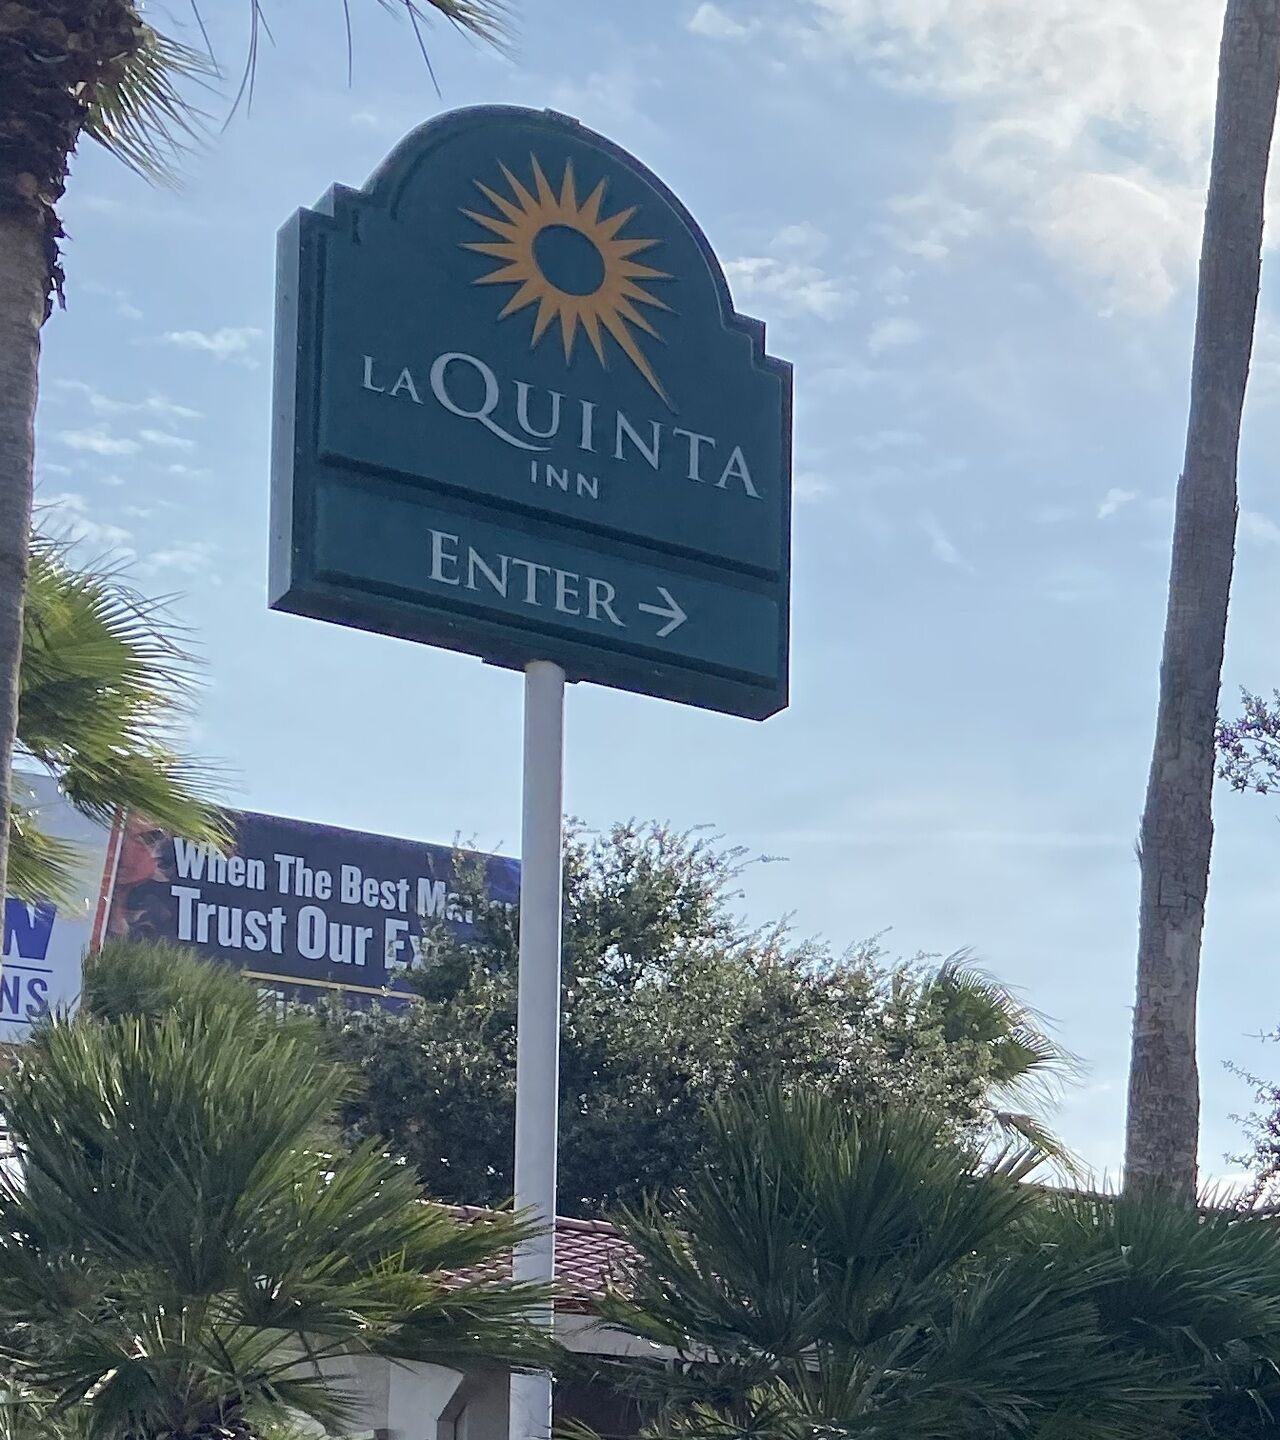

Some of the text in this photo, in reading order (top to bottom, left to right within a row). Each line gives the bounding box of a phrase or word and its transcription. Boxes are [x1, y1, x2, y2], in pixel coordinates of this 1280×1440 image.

[430, 352, 764, 500] QUINTA
[530, 459, 599, 499] INN
[426, 528, 627, 627] ENTER
[173, 837, 266, 891] When
[273, 852, 332, 901] The
[340, 864, 410, 913] Best
[171, 884, 287, 955] Trust
[296, 905, 373, 967] Our
